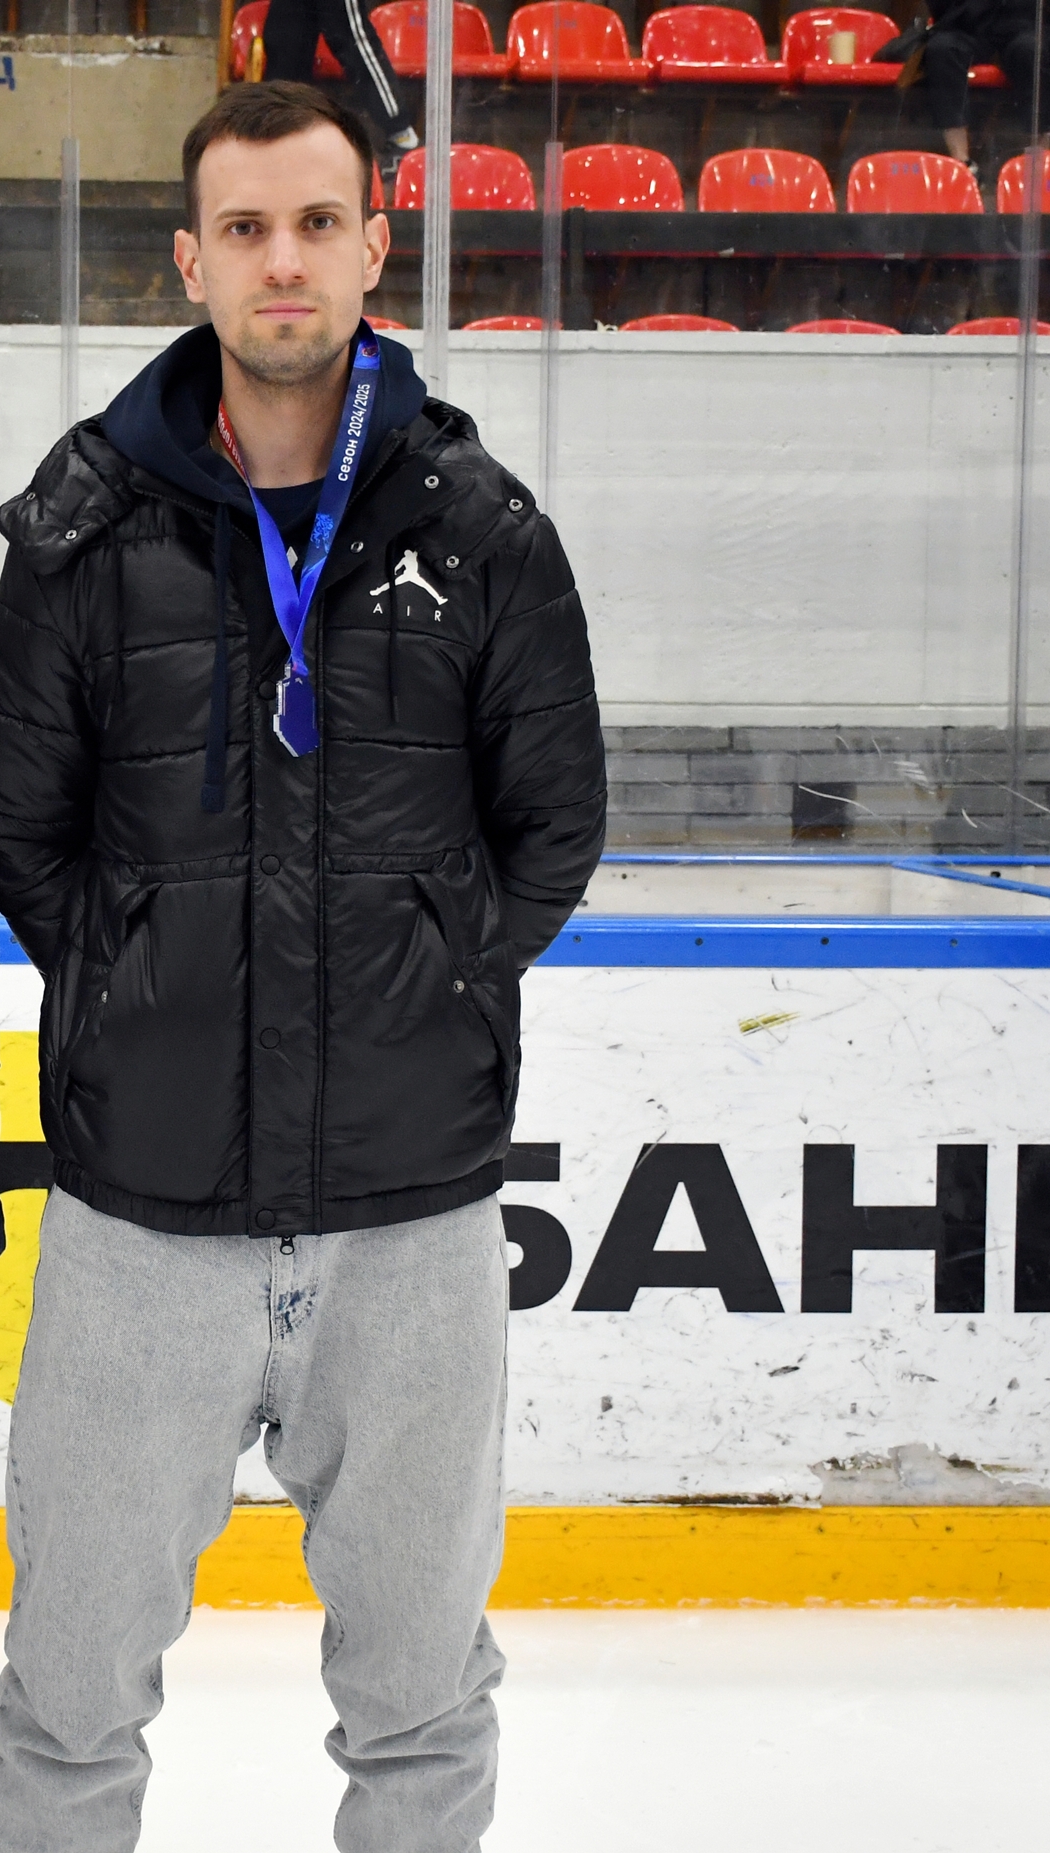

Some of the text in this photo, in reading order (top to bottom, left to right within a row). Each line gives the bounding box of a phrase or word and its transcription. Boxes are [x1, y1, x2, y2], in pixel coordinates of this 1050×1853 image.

[338, 383, 371, 482] сезон 2024/2025
[372, 602, 443, 623] AIR
[502, 1142, 1050, 1314] БАН
